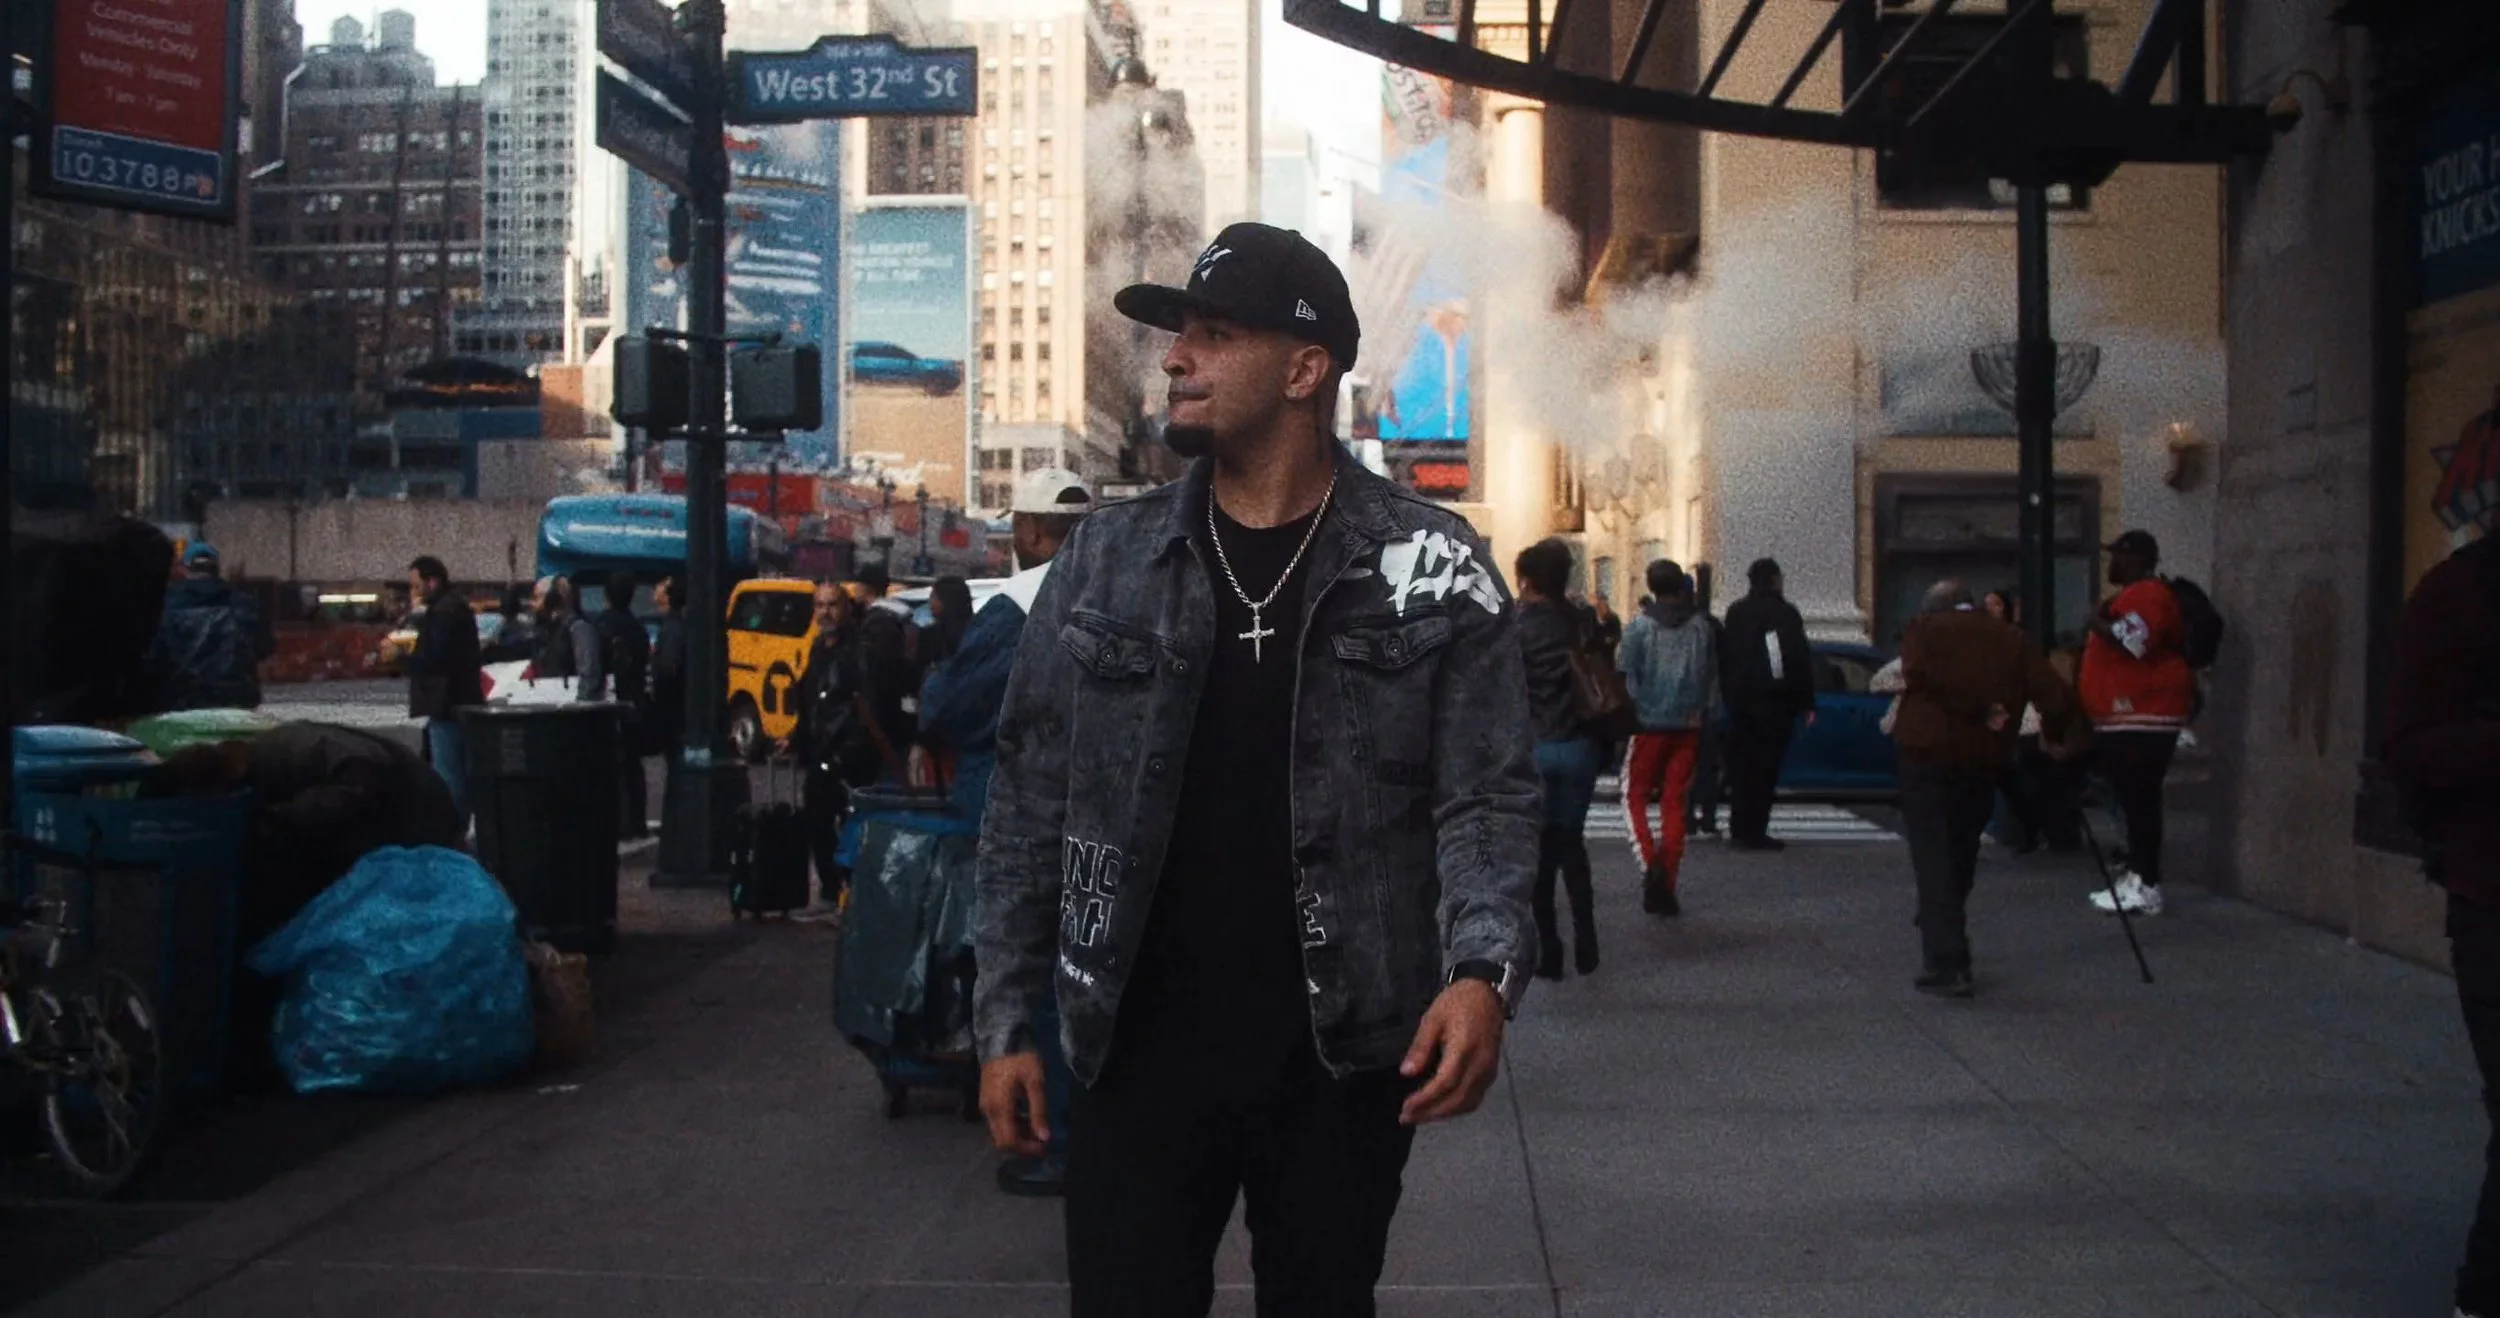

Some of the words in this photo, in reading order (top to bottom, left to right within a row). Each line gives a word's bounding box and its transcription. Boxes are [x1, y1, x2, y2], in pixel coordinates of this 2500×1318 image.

[754, 69, 840, 102] West
[848, 64, 914, 99] 32nd
[924, 65, 959, 98] St
[2421, 140, 2485, 206] YOUR
